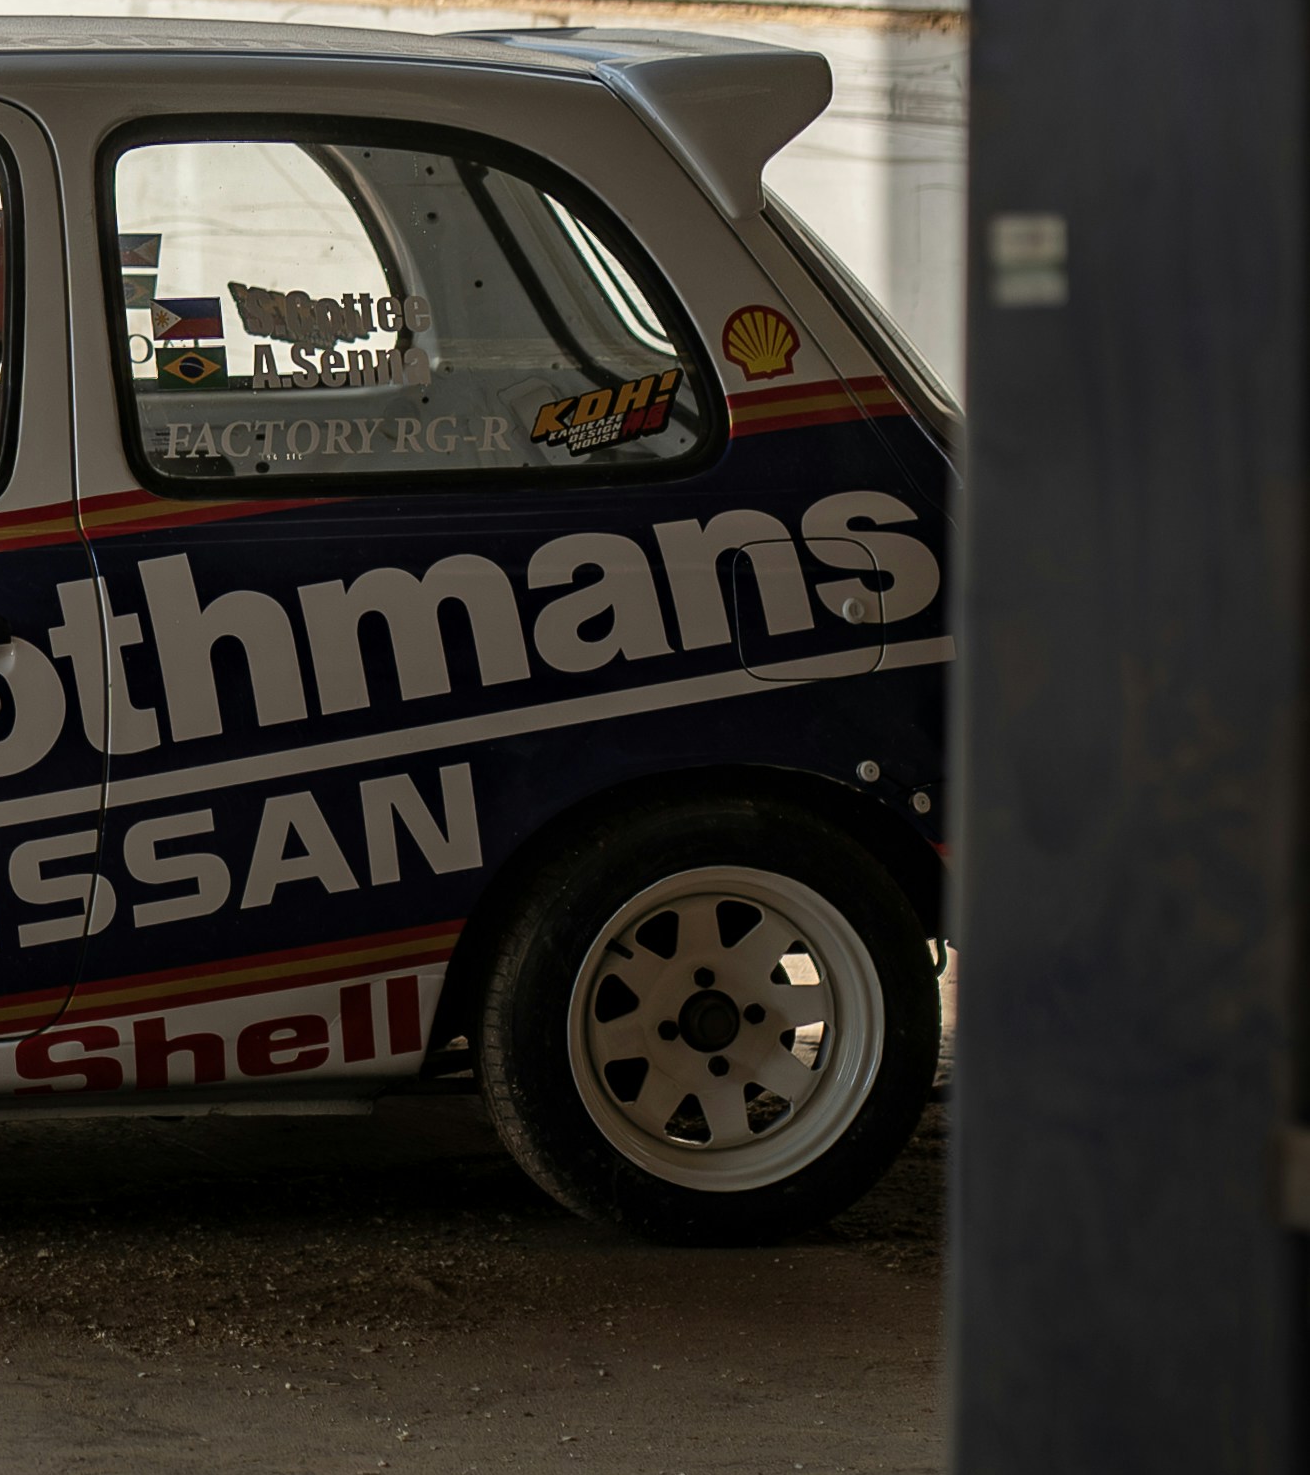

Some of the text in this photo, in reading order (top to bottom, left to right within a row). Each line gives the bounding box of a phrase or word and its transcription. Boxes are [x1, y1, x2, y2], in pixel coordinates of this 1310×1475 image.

[252, 343, 432, 389] A.Senna
[163, 416, 512, 459] FACTORY RG-R
[548, 413, 625, 441] KAMIKAZE
[568, 422, 623, 444] DESIGN
[14, 974, 422, 1095] Shell
